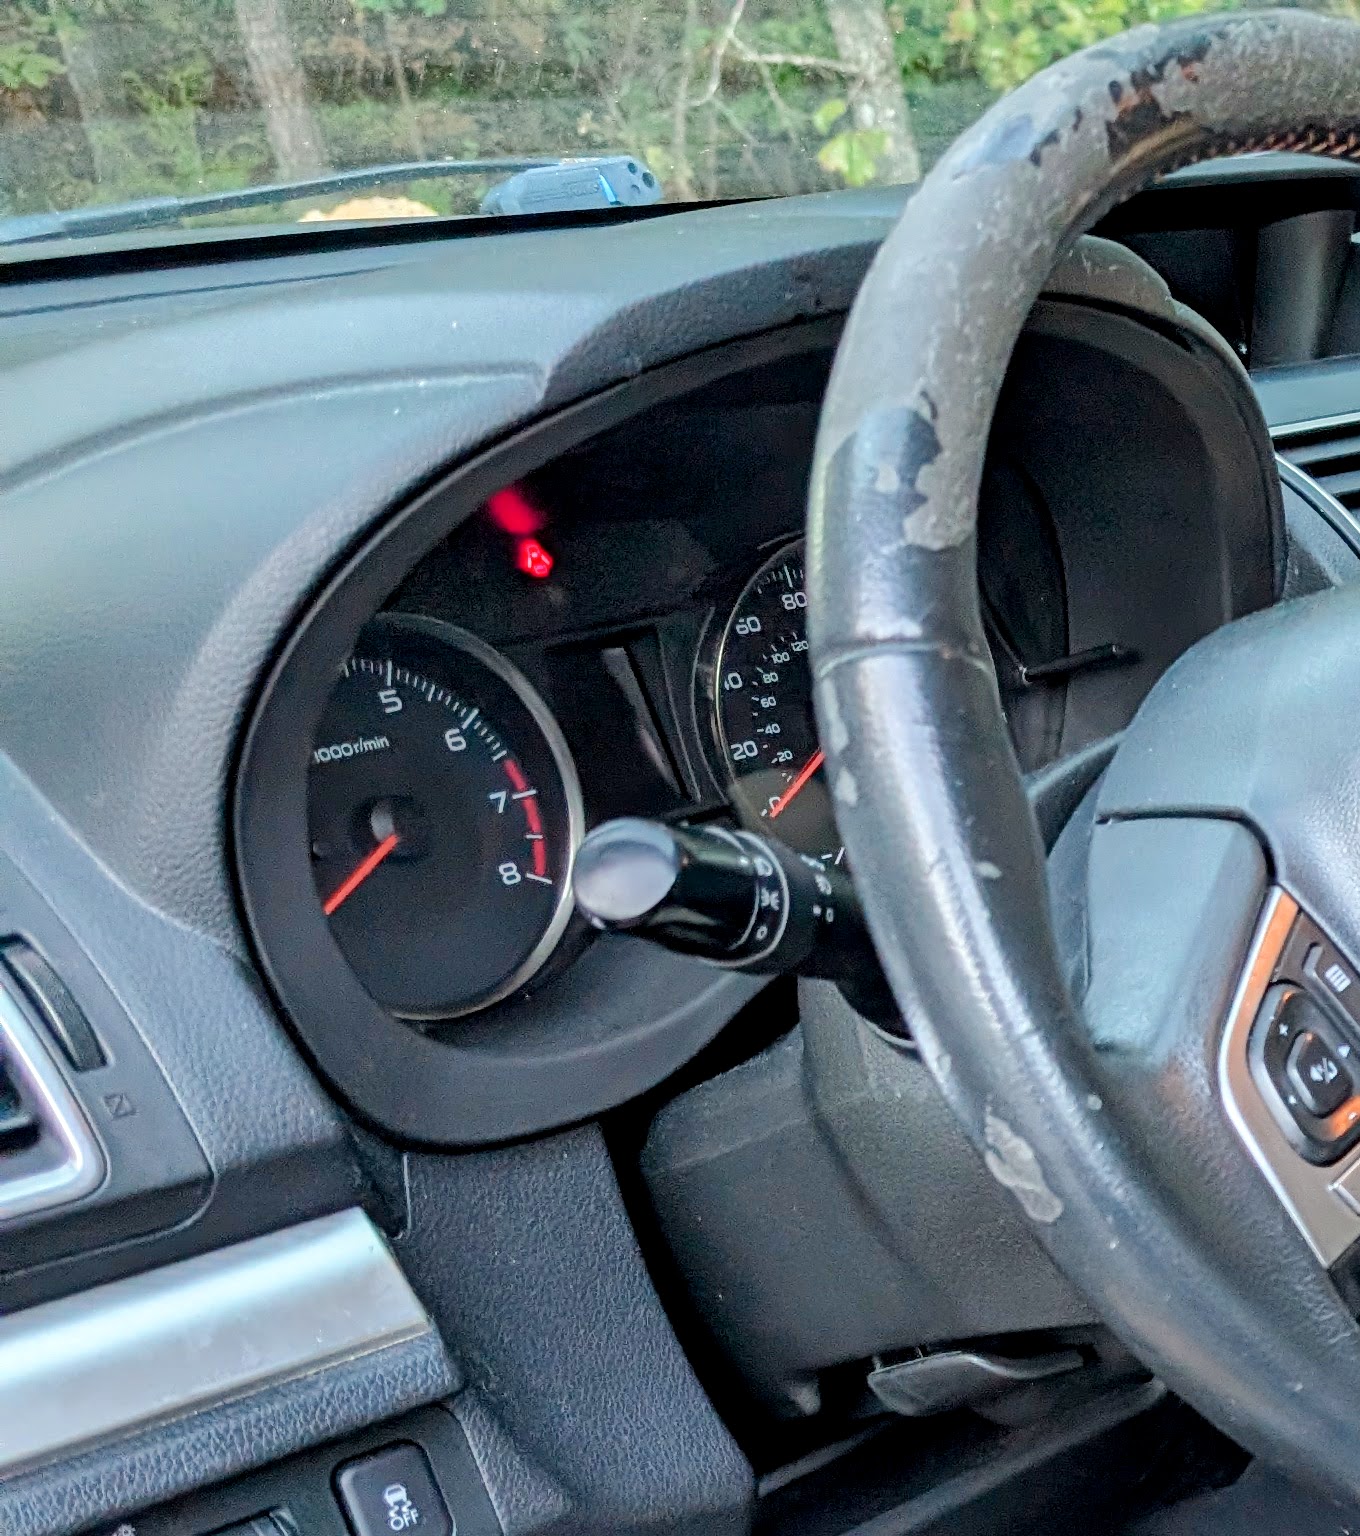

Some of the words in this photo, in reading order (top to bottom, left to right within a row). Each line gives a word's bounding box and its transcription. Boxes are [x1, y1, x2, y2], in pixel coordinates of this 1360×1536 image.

[781, 591, 808, 611] 80
[790, 640, 809, 652] 120
[771, 651, 791, 664] 100
[762, 672, 779, 684] 80
[378, 689, 403, 714] 5
[760, 696, 777, 708] 60
[764, 723, 781, 735] 40
[444, 728, 467, 752] 6
[730, 740, 758, 761] 20
[776, 750, 793, 762] 20
[489, 790, 507, 814] 7
[498, 861, 522, 885] 8
[390, 1508, 419, 1531] OFF
